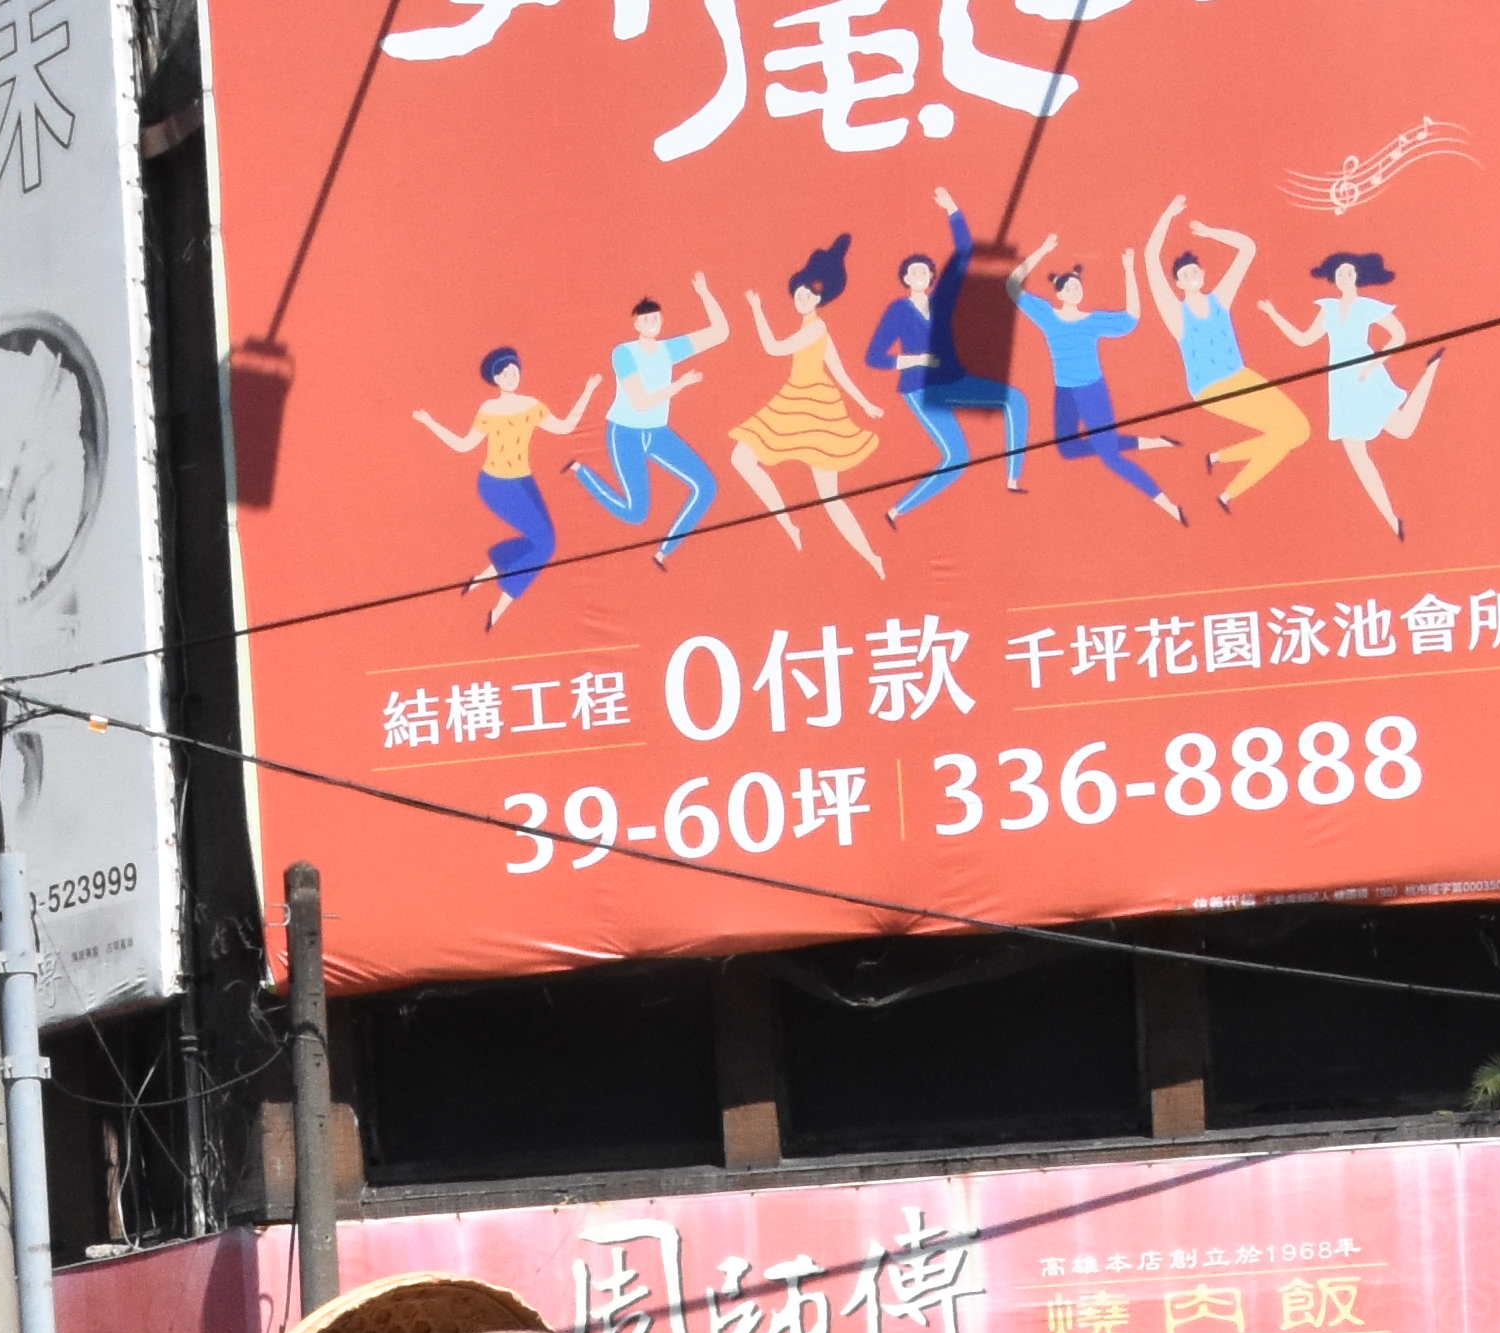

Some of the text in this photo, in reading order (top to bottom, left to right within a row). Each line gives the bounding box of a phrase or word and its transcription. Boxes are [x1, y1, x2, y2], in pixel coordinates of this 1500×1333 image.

[384, 668, 632, 750] 結構工程
[502, 764, 872, 873] 39-60坪
[932, 716, 1425, 838] 336-8888
[1038, 1236, 1362, 1280] 高雄本店創立於1968年
